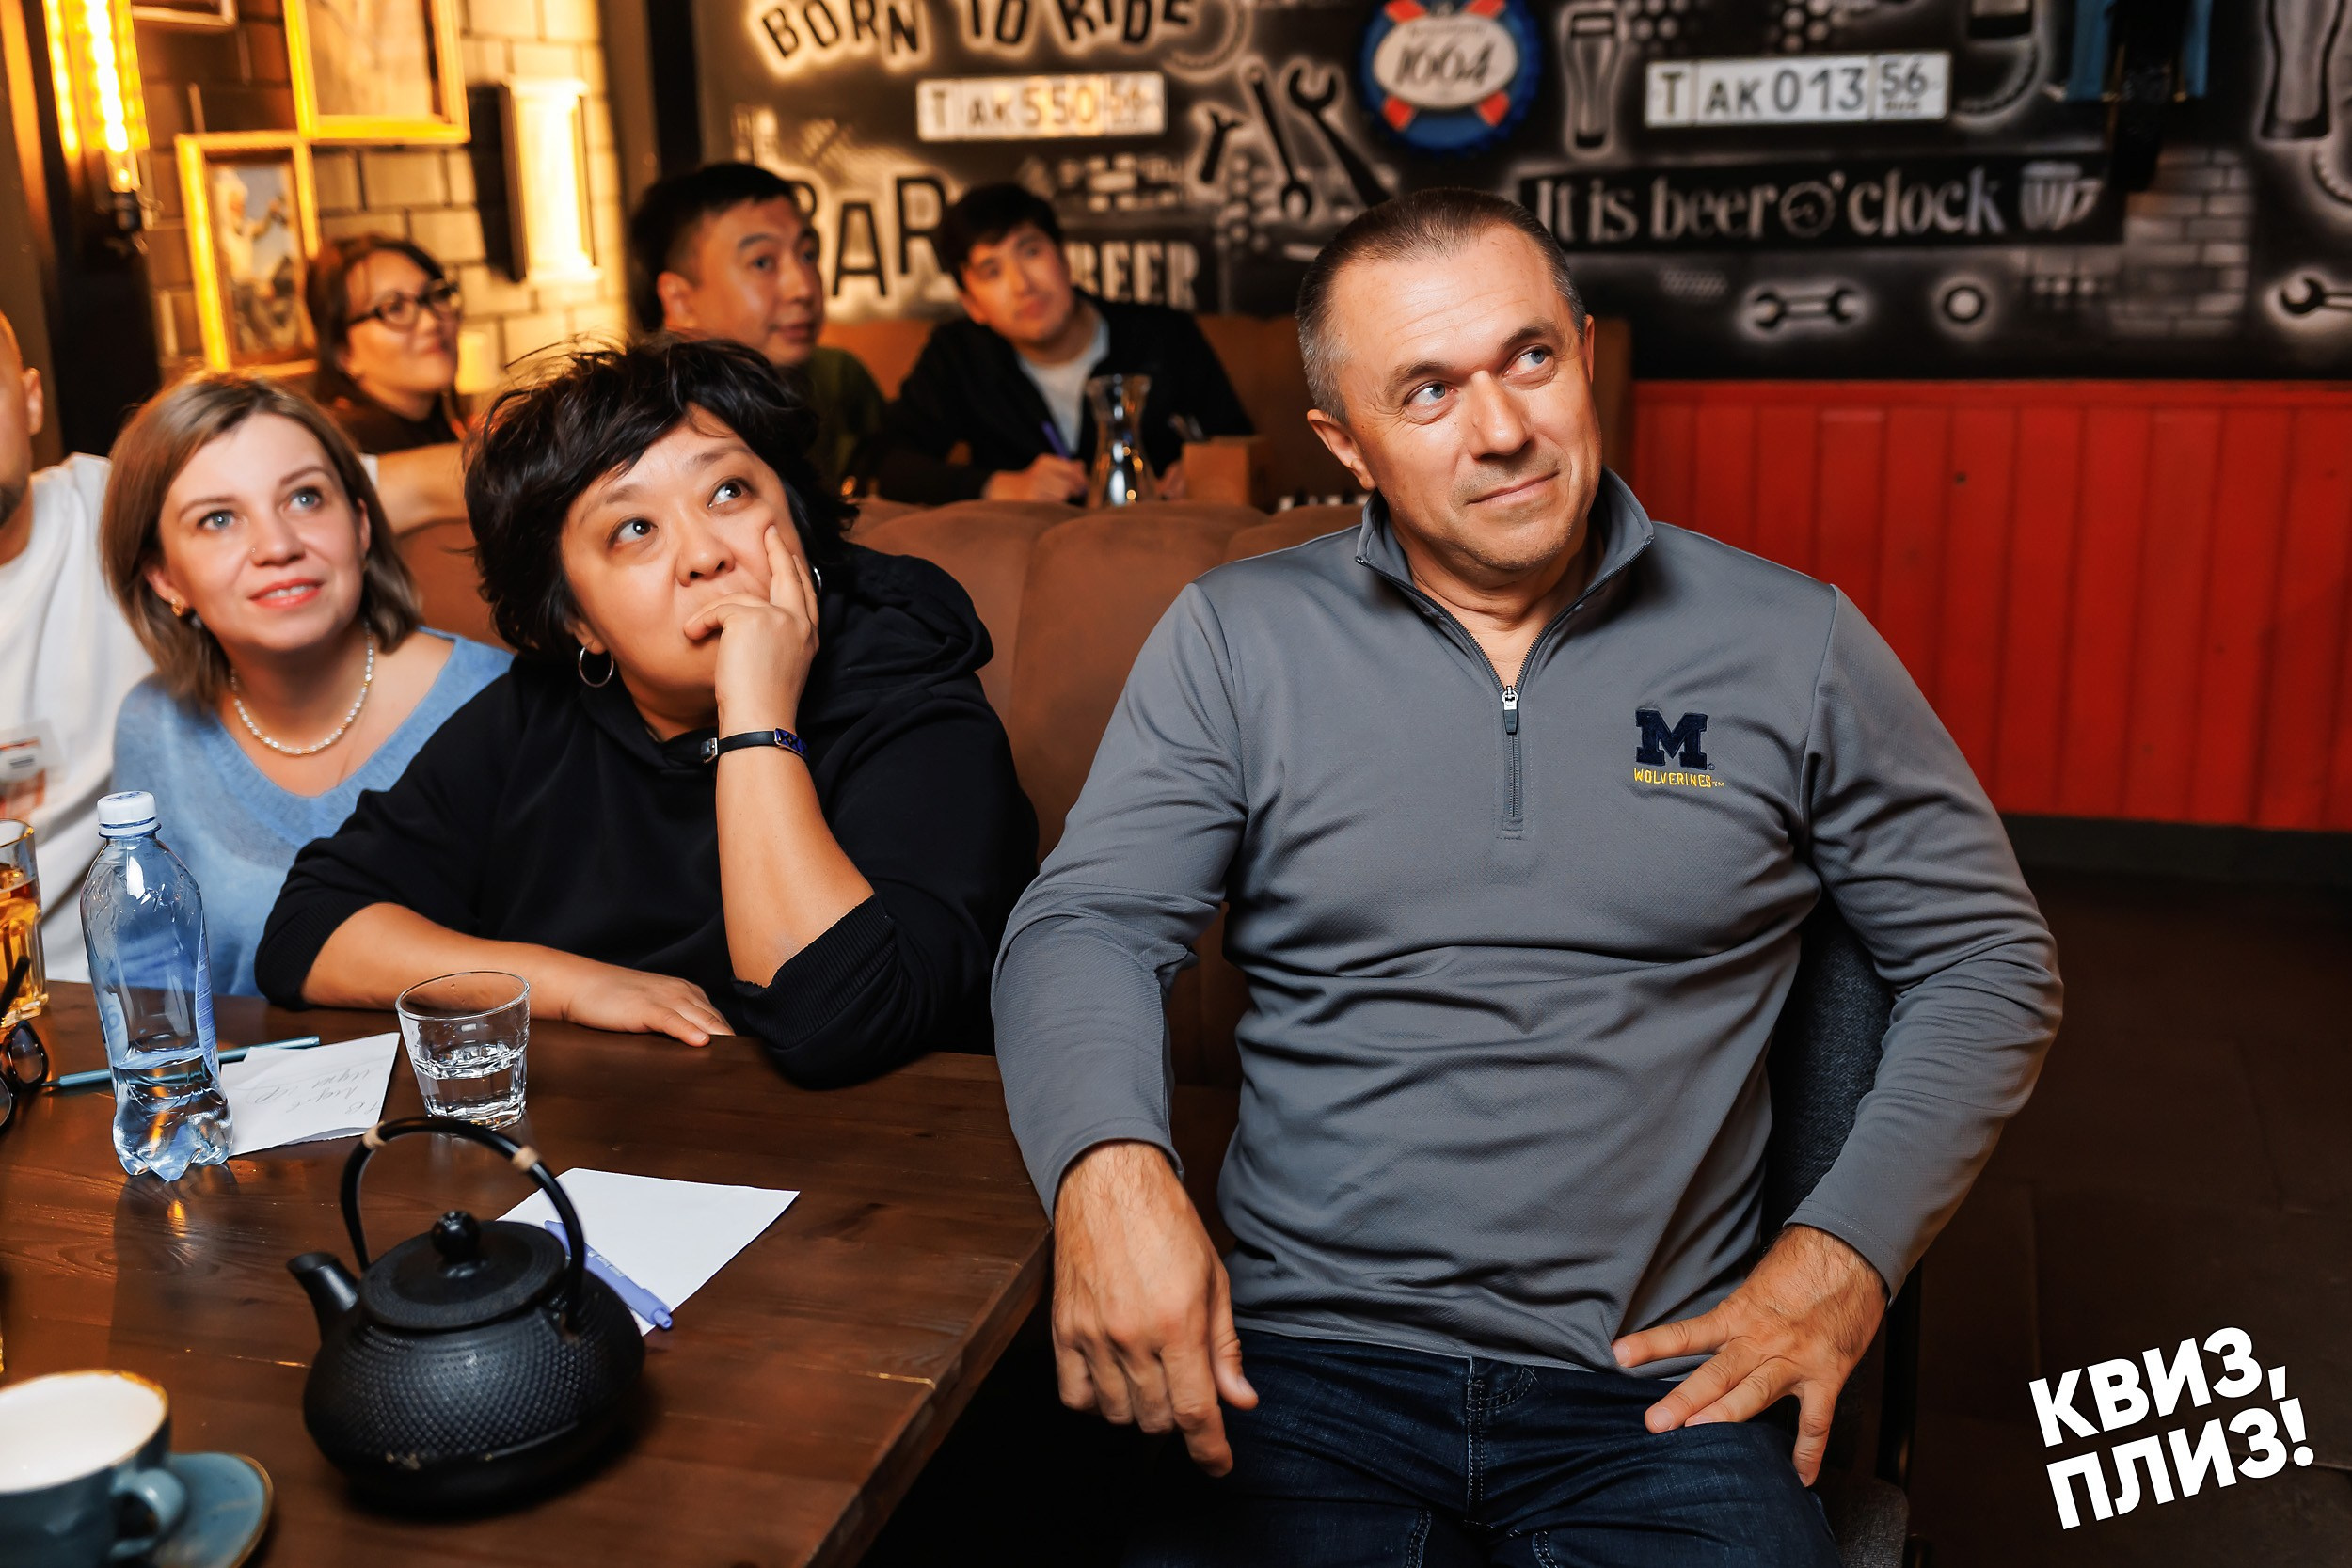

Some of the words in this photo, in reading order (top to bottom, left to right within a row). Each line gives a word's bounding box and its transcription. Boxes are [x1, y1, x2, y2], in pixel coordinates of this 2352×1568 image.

[761, 0, 918, 58] BORN
[1590, 177, 1639, 242] is
[1650, 175, 1777, 241] beer
[1635, 708, 1708, 770] M
[1633, 768, 1711, 788] WOLVERINES
